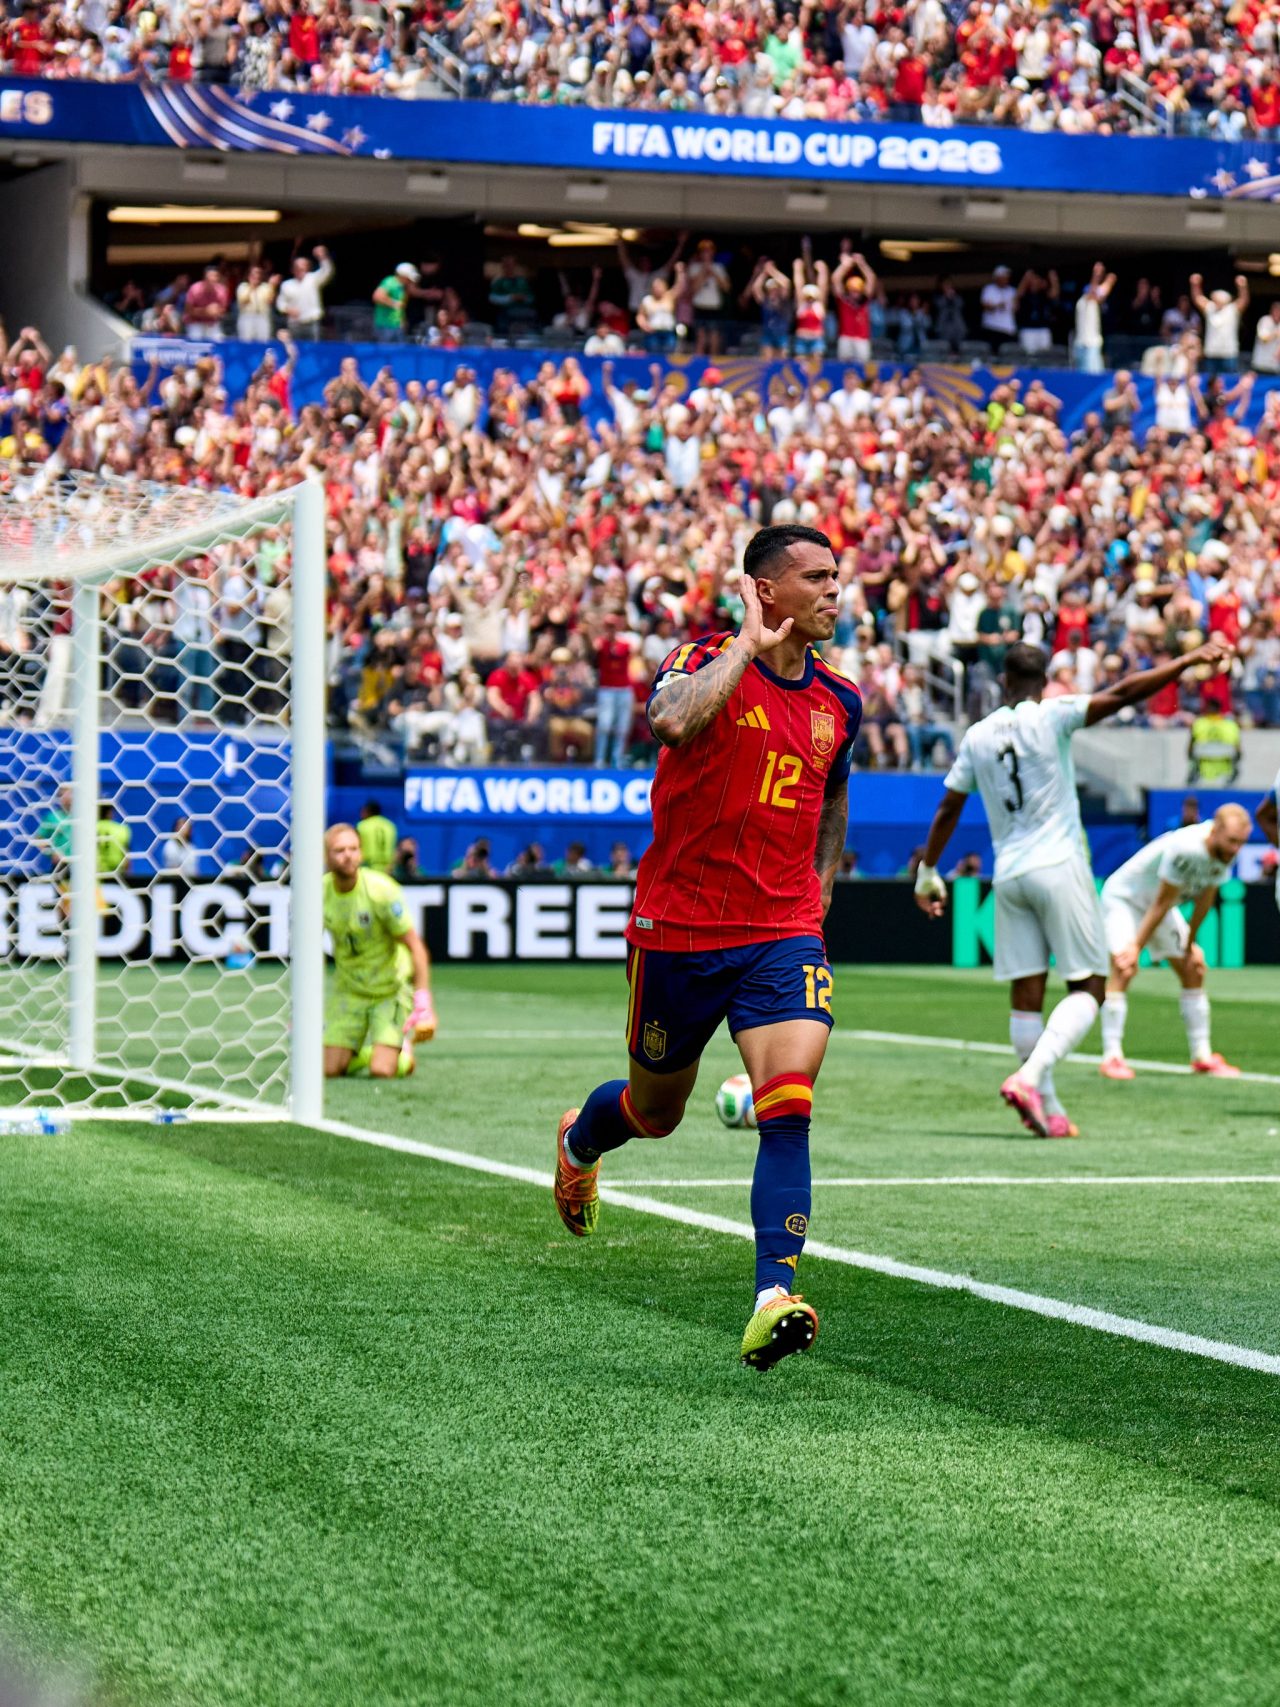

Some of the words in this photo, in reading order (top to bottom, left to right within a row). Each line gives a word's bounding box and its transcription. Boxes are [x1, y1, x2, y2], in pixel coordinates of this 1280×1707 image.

[592, 122, 669, 158] FIFA
[672, 126, 801, 164] WORLD
[804, 131, 876, 168] CUP
[878, 136, 1001, 174] 2026
[404, 776, 484, 813] FIFA
[482, 778, 622, 815] WORLD
[759, 751, 803, 809] 12
[997, 743, 1023, 813] 3
[802, 964, 833, 1015] 12
